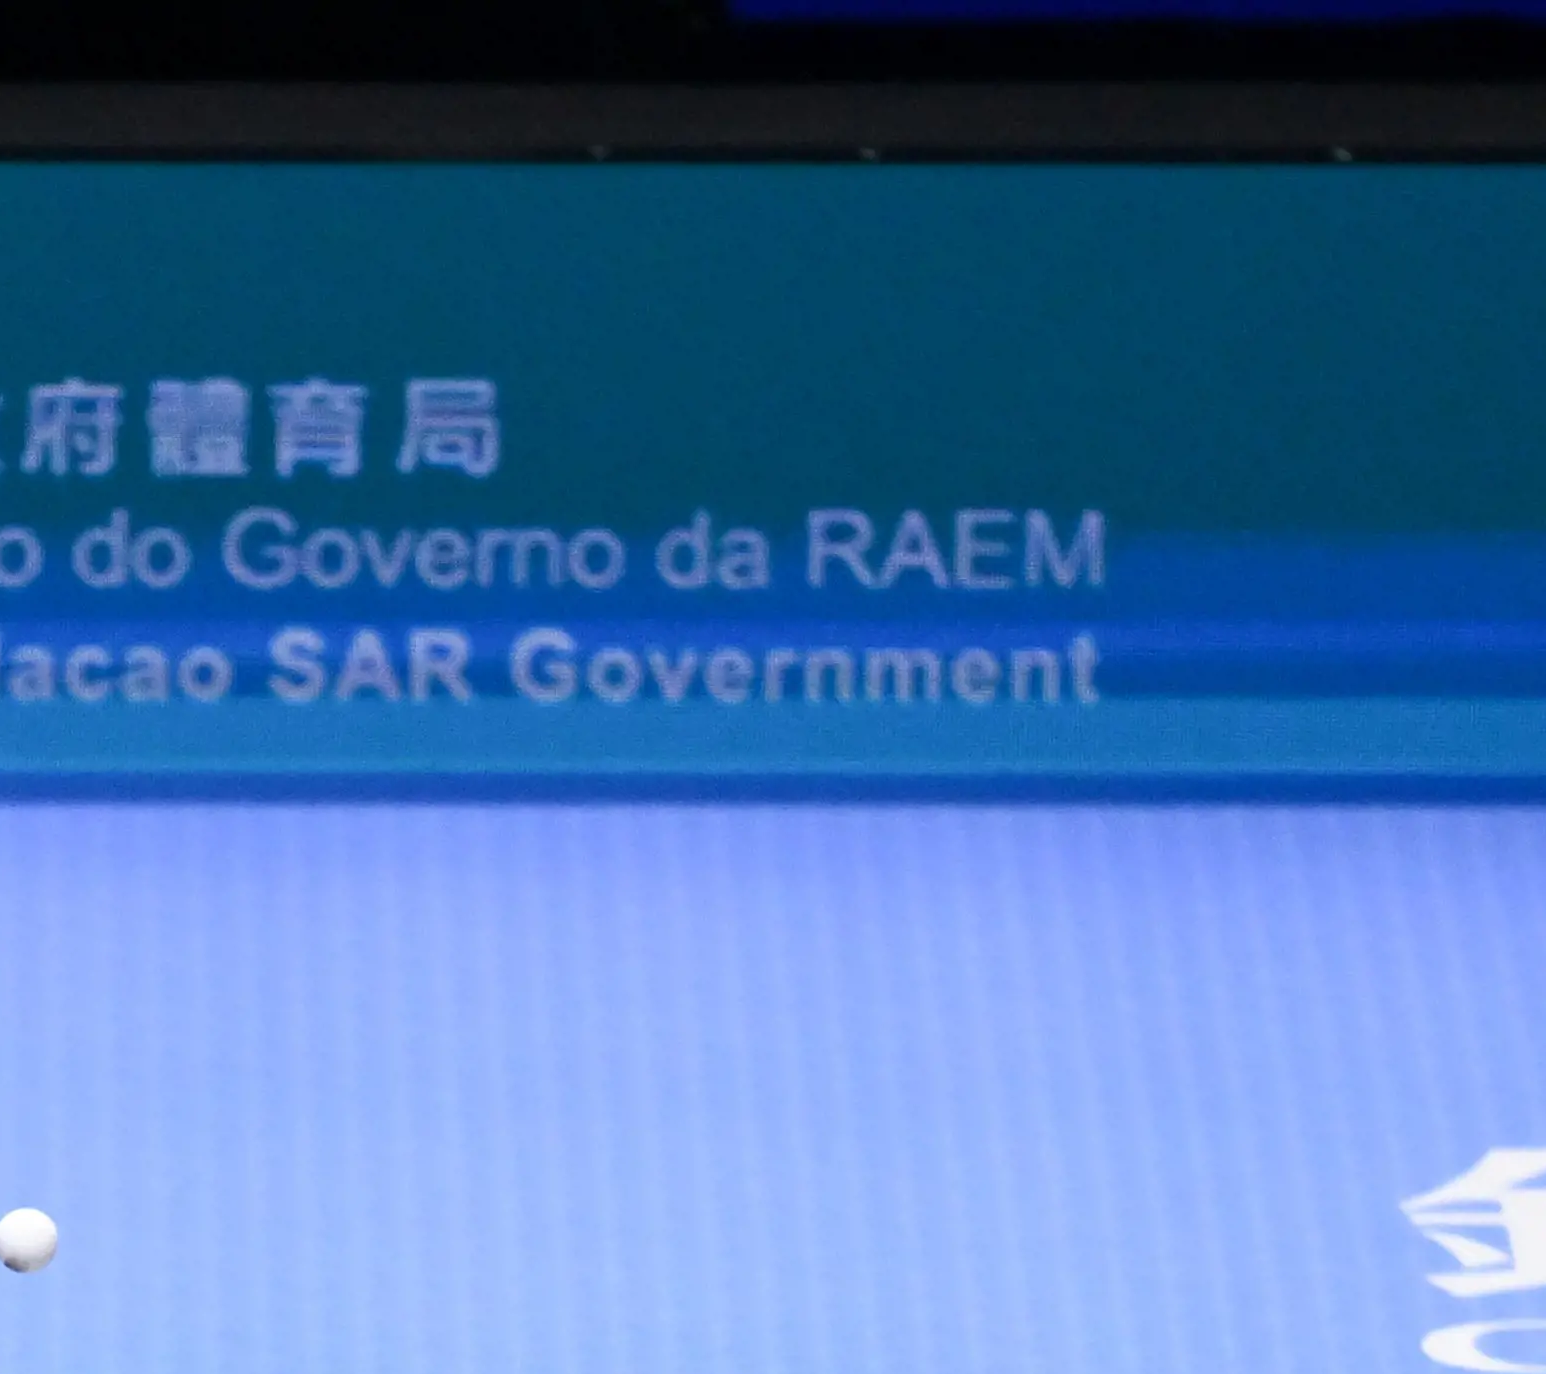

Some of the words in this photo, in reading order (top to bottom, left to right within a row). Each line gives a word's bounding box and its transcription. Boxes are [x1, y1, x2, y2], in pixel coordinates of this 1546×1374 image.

[71, 509, 192, 589] do
[221, 506, 627, 590] Governo
[654, 509, 772, 590] da
[805, 509, 1107, 590] RAEM
[267, 628, 472, 702] SAR
[510, 627, 1102, 703] Government
